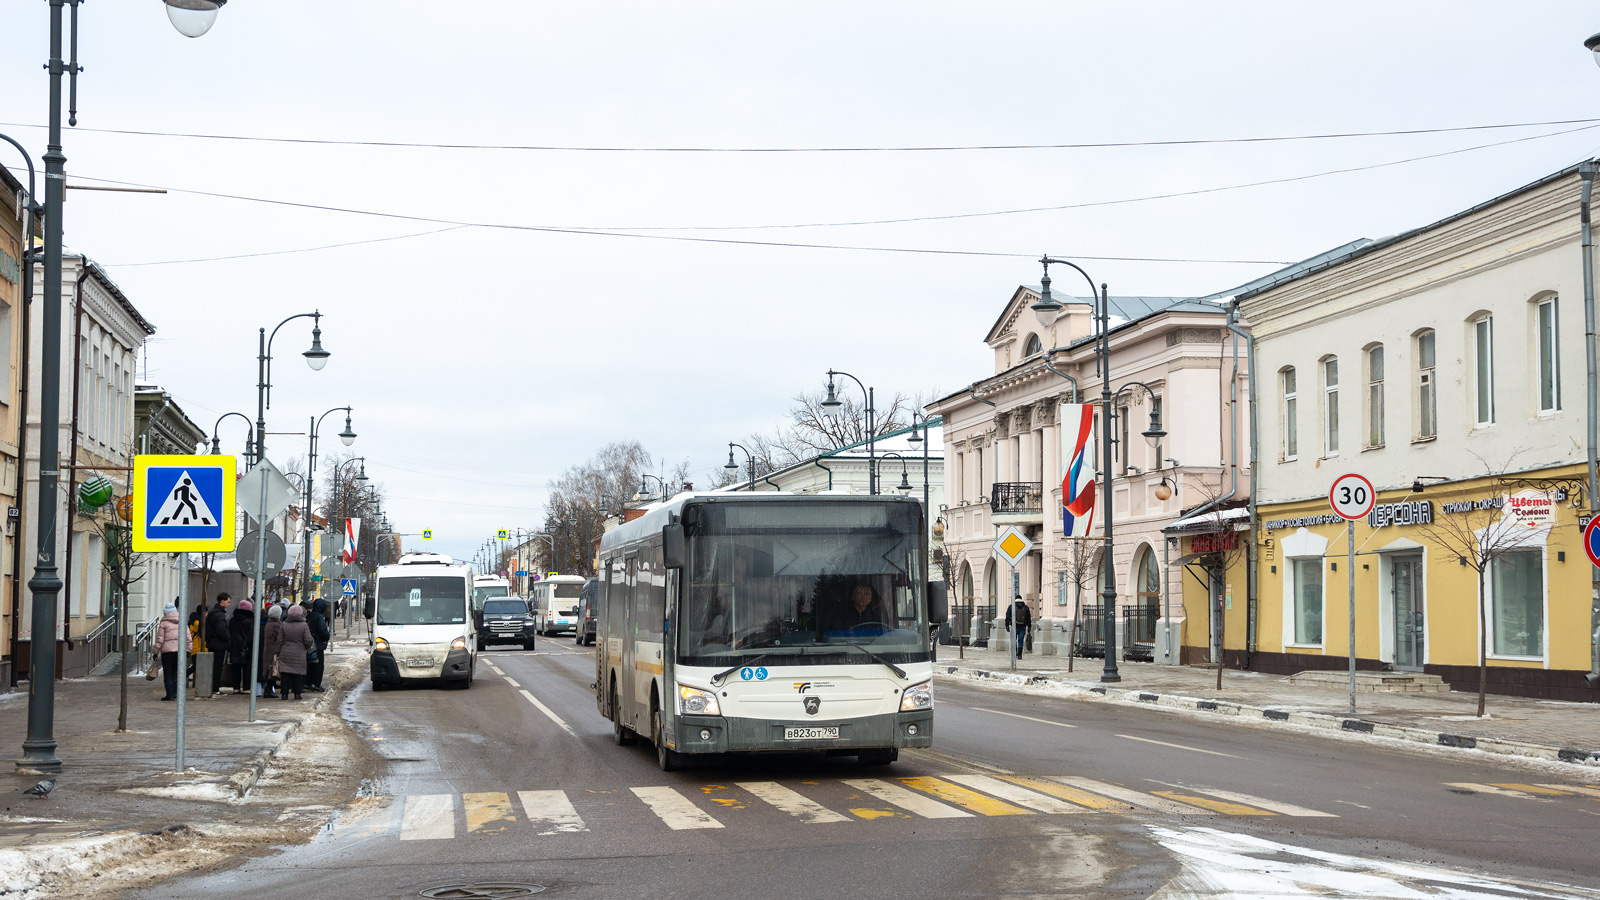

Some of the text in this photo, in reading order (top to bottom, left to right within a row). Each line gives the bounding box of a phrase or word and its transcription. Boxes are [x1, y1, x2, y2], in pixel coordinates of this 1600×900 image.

[1339, 486, 1366, 505] 30
[1508, 497, 1552, 508] Цветы
[1441, 497, 1504, 514] СТРИЖКИ ОКРАШ
[1368, 501, 1432, 527] ПЕРСОНА
[410, 591, 420, 601] 10
[787, 727, 837, 738] В823ОТ 790
